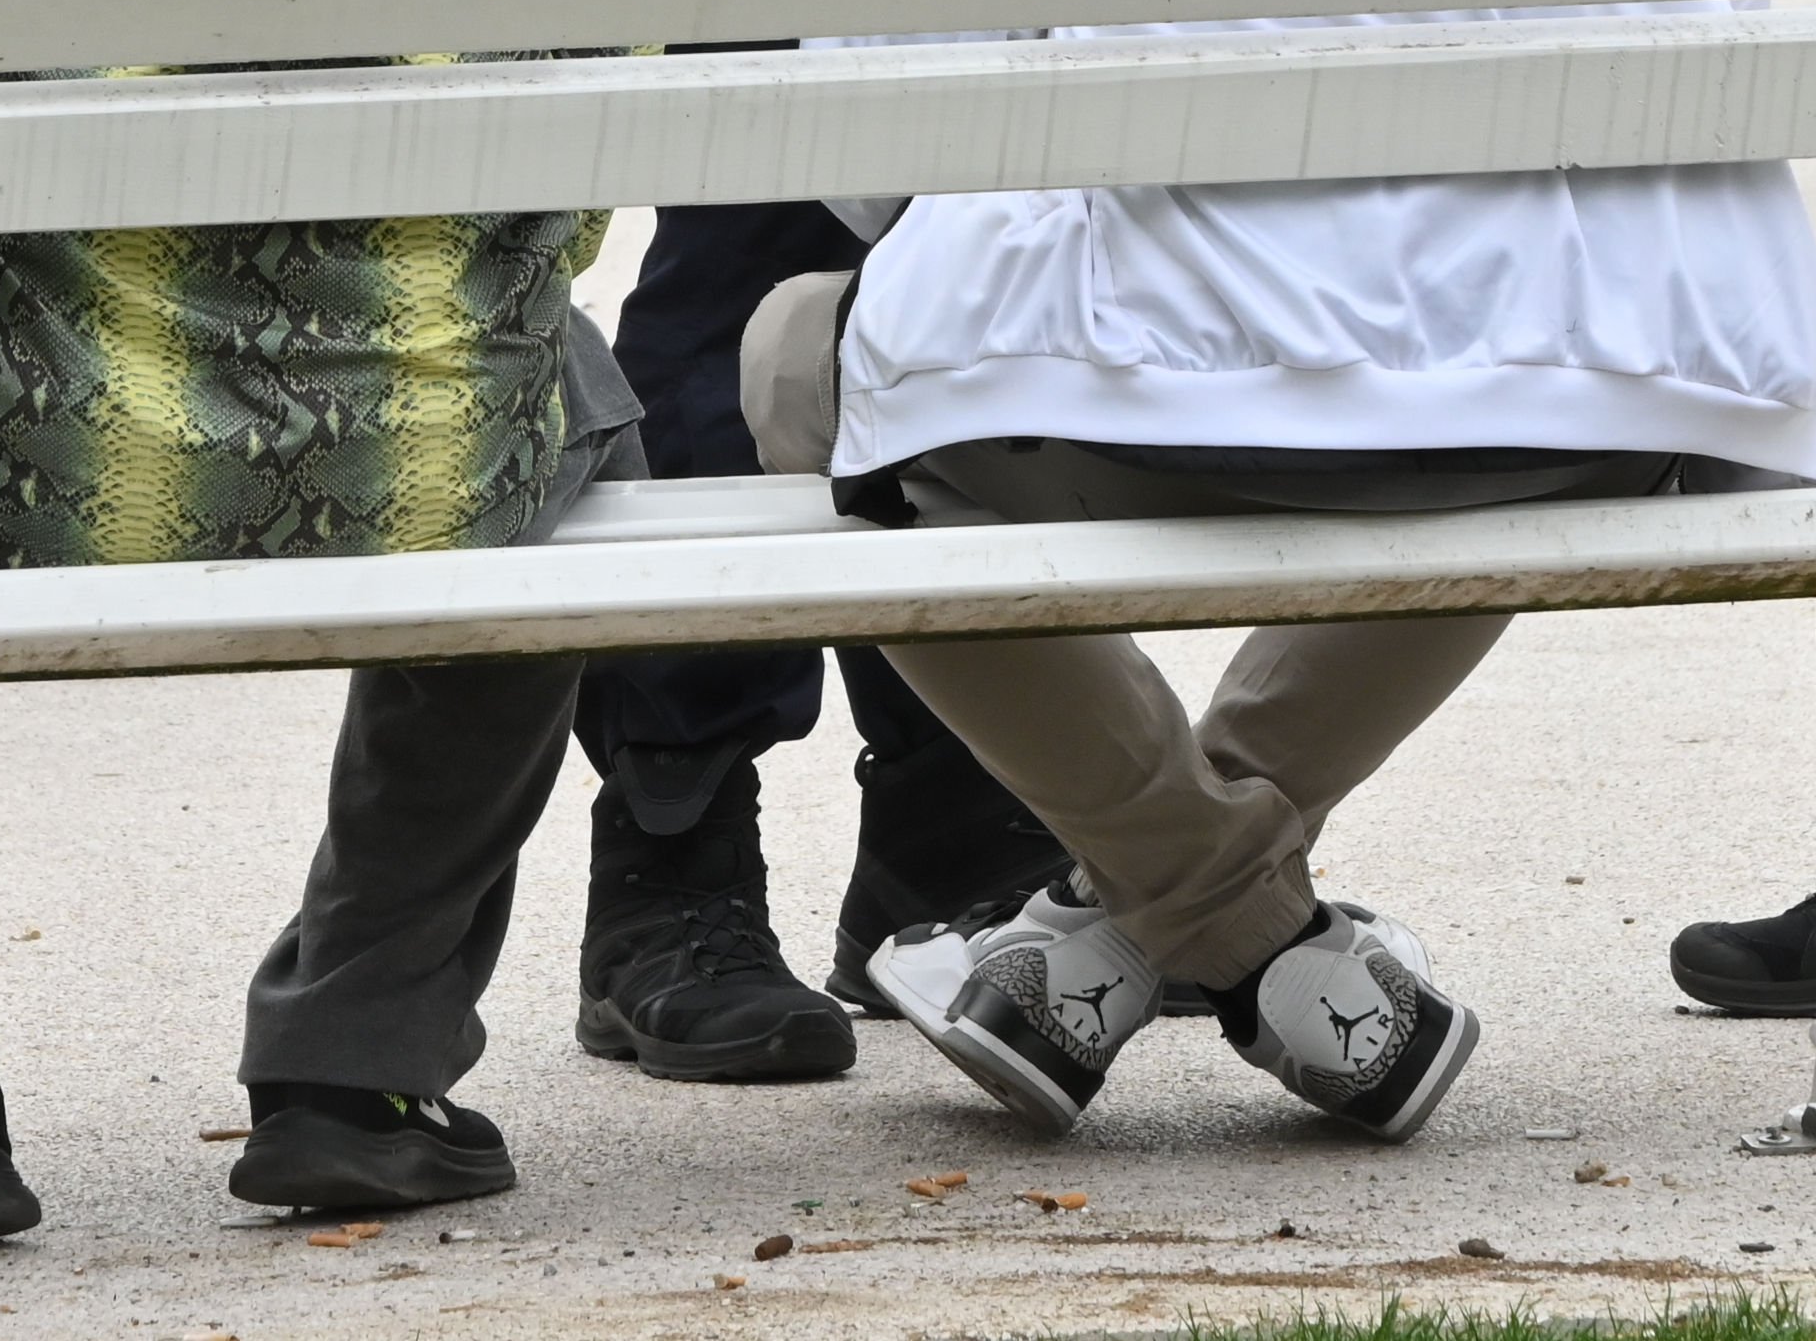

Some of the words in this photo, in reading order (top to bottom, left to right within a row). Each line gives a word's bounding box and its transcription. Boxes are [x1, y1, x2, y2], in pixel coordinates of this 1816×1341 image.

[1050, 1002, 1101, 1050] AIR
[1352, 1013, 1395, 1071] AIR
[383, 1091, 408, 1116] OOM
